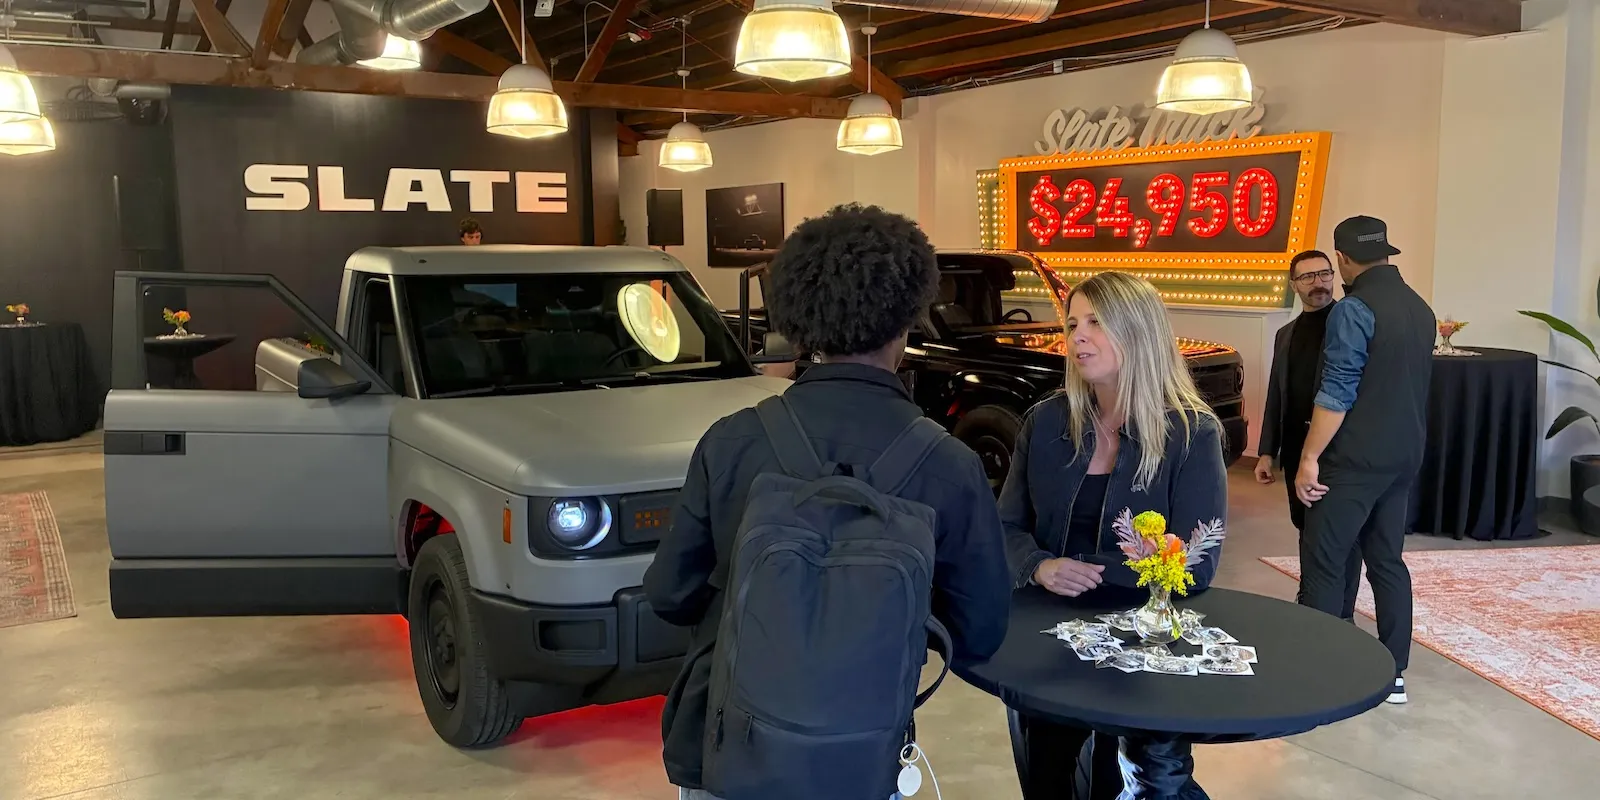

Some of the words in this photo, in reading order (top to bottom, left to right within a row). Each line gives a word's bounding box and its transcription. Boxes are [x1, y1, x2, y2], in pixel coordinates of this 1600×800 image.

[1034, 105, 1134, 156] Slate
[244, 164, 567, 213] SLATE
[1028, 167, 1279, 249] $24,950
